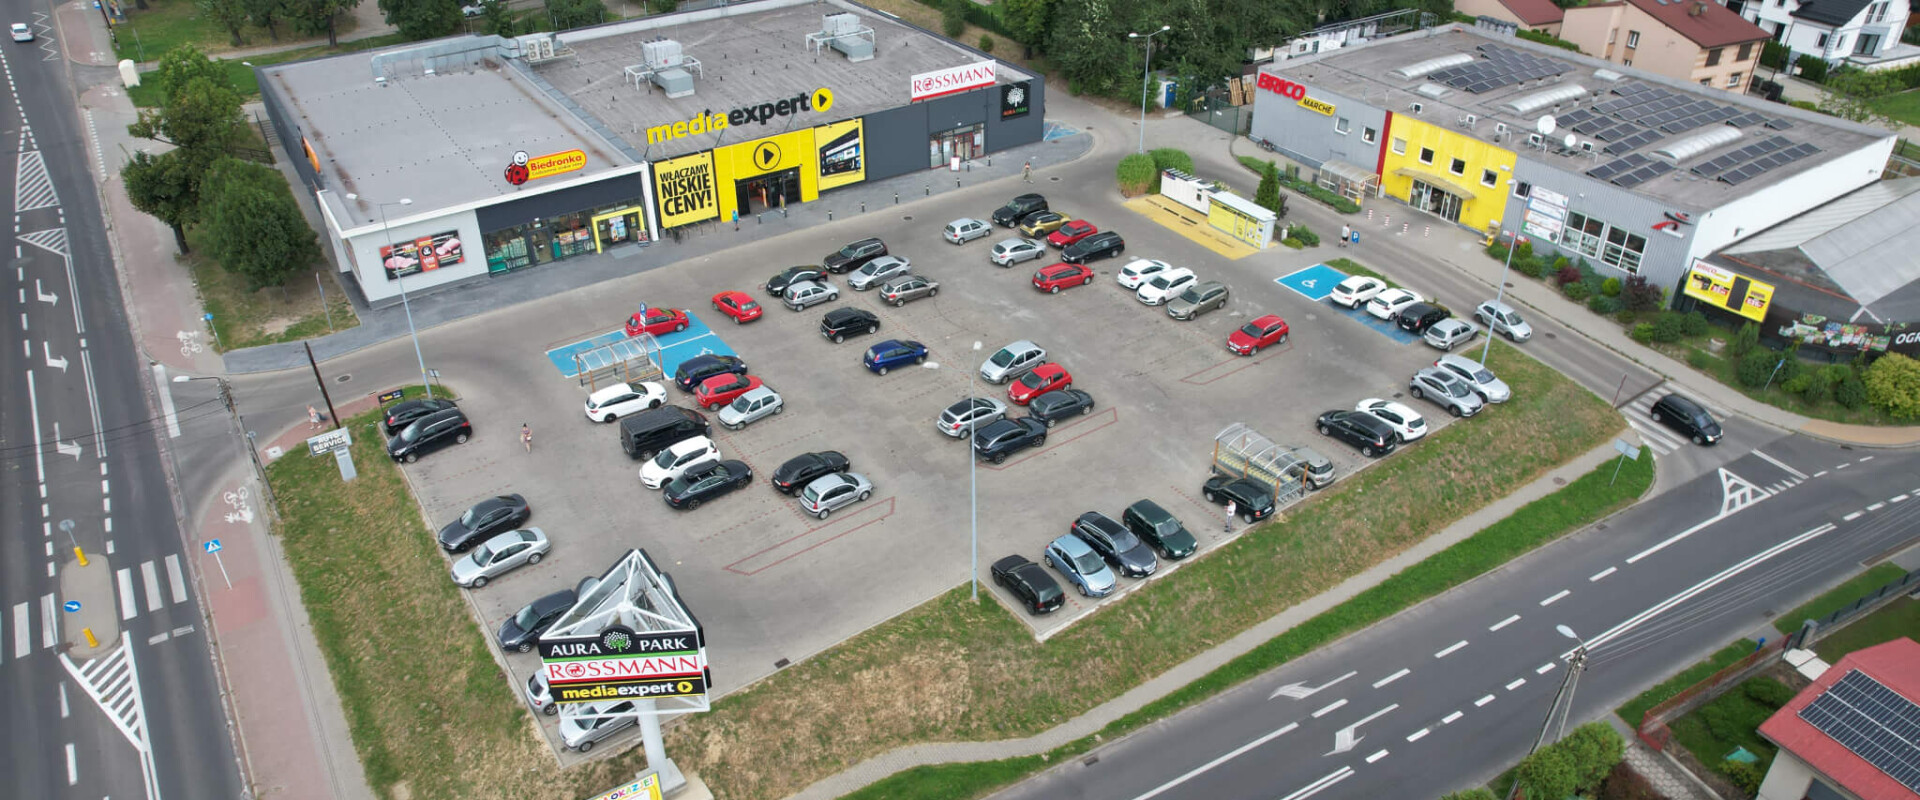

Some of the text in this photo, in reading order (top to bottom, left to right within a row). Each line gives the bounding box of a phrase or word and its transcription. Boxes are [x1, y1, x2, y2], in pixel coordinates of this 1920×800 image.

[913, 64, 995, 94] ROSSMANN
[1257, 72, 1306, 101] BRICO
[646, 92, 811, 145] mediaexpert
[530, 154, 582, 171] Biedronka
[661, 173, 711, 199] NISKIE
[663, 190, 712, 216] CENY!
[550, 638, 689, 657] AURA PARK
[549, 656, 698, 679] ROSSMANN
[562, 682, 675, 699] mediaexpert
